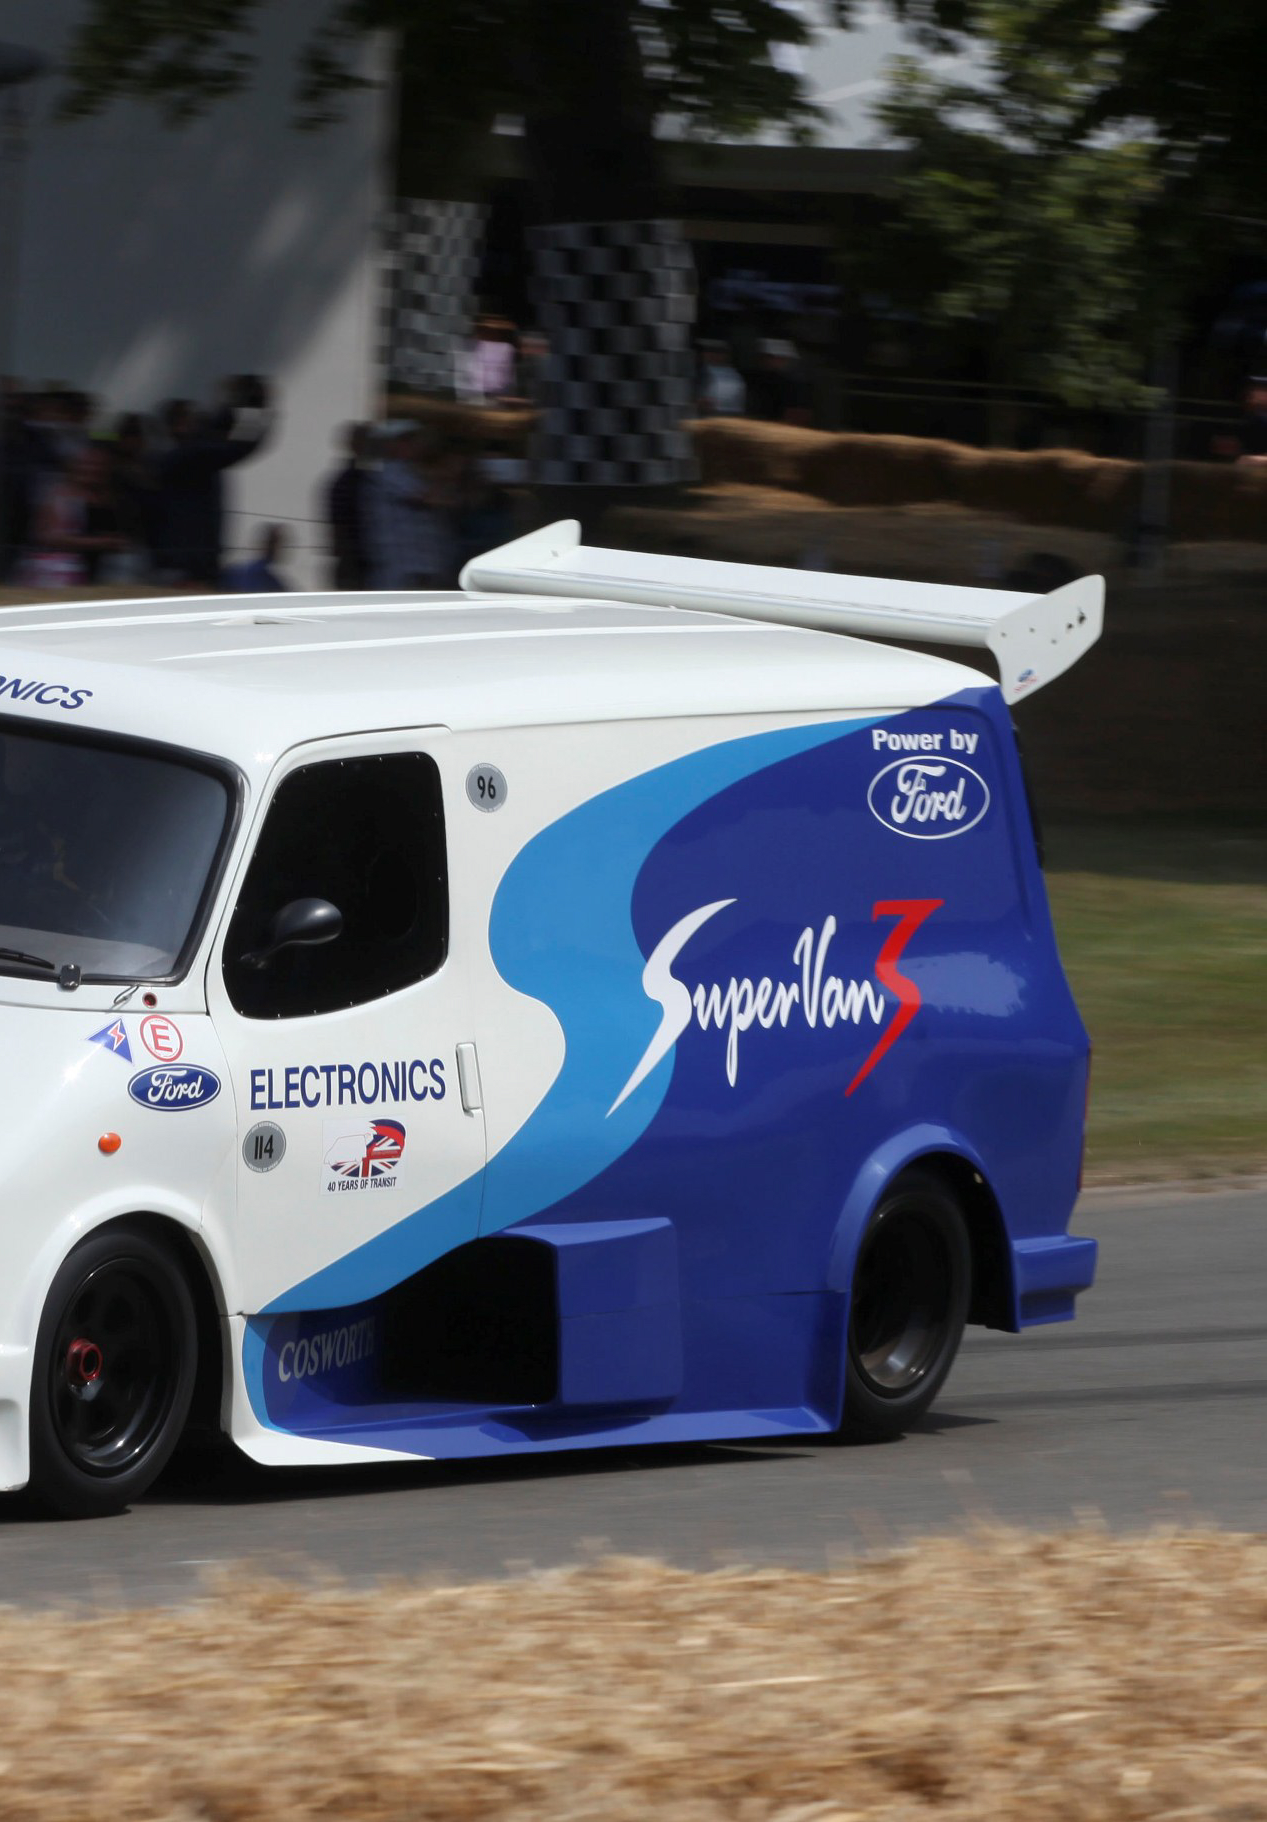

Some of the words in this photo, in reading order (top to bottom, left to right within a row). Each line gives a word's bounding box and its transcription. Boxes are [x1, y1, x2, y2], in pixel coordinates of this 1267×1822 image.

[871, 728, 944, 751] Power
[949, 728, 979, 755] by
[476, 775, 497, 800] 96
[890, 763, 968, 824] Ford
[150, 1023, 173, 1053] E
[146, 1068, 205, 1102] Ford
[249, 1058, 447, 1111] ELECTRONICS
[254, 1134, 274, 1160] 114
[327, 1181, 336, 1192] 40
[337, 1179, 359, 1191] YEARS
[360, 1178, 369, 1190] OF
[369, 1176, 398, 1189] TRANSIT
[278, 1315, 377, 1383] COSWORTH
